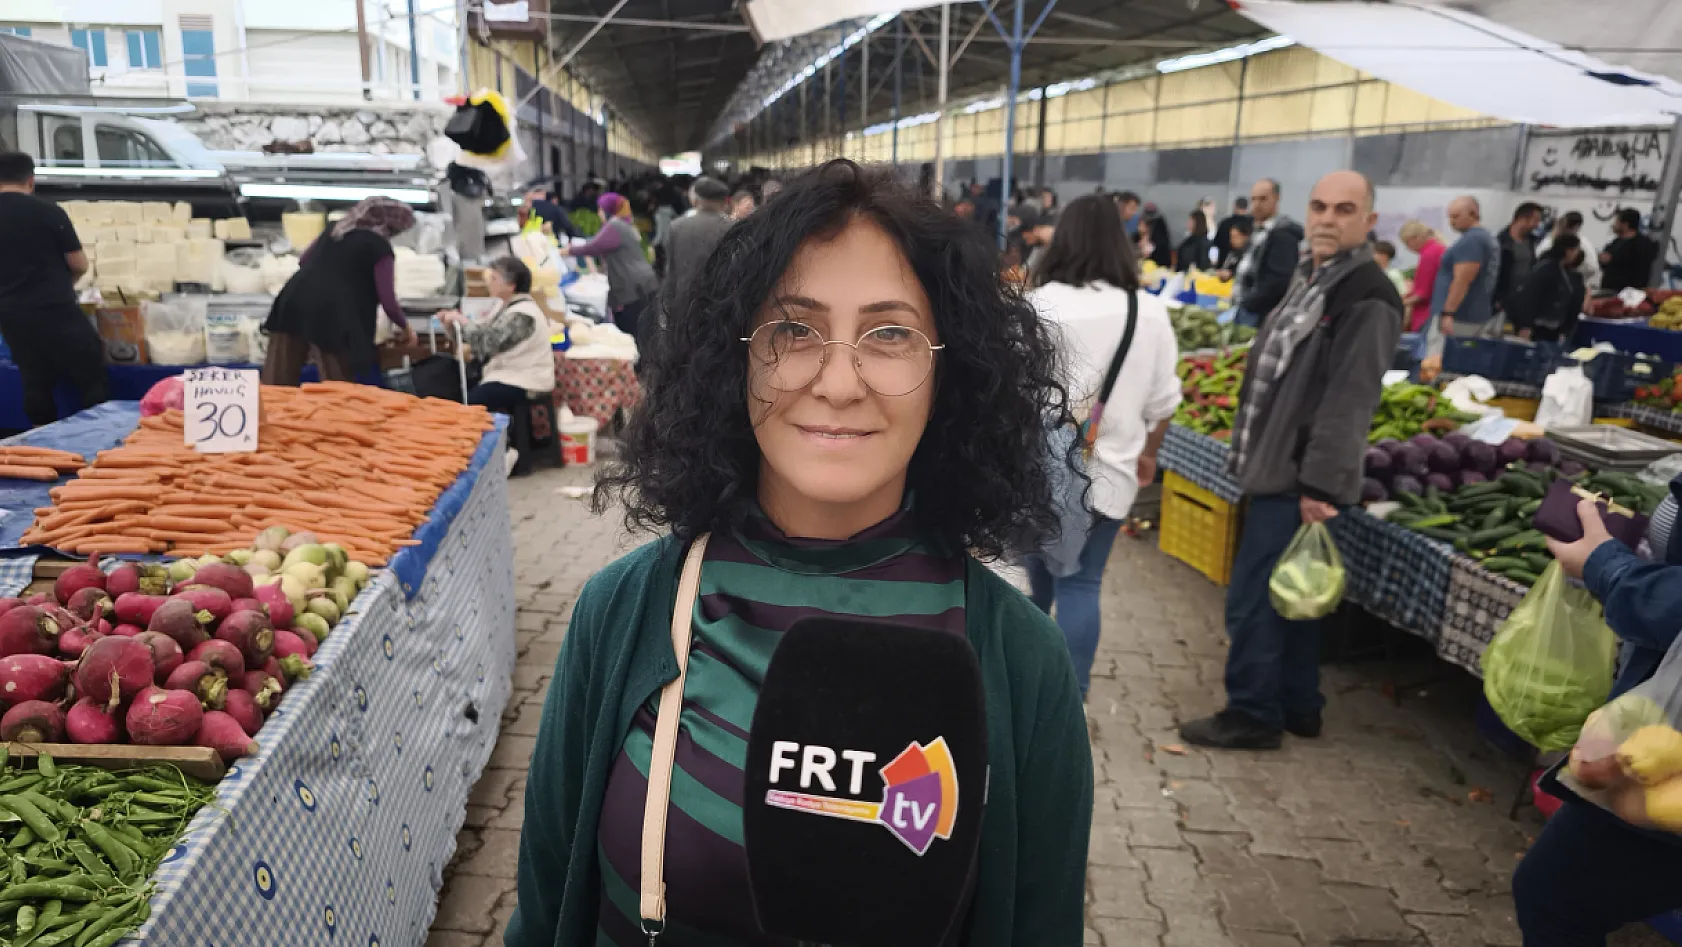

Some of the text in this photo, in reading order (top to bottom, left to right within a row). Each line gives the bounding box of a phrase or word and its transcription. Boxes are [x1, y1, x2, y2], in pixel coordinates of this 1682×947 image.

[195, 401, 247, 443] 30
[768, 740, 878, 796] FRT
[891, 790, 937, 831] tv
